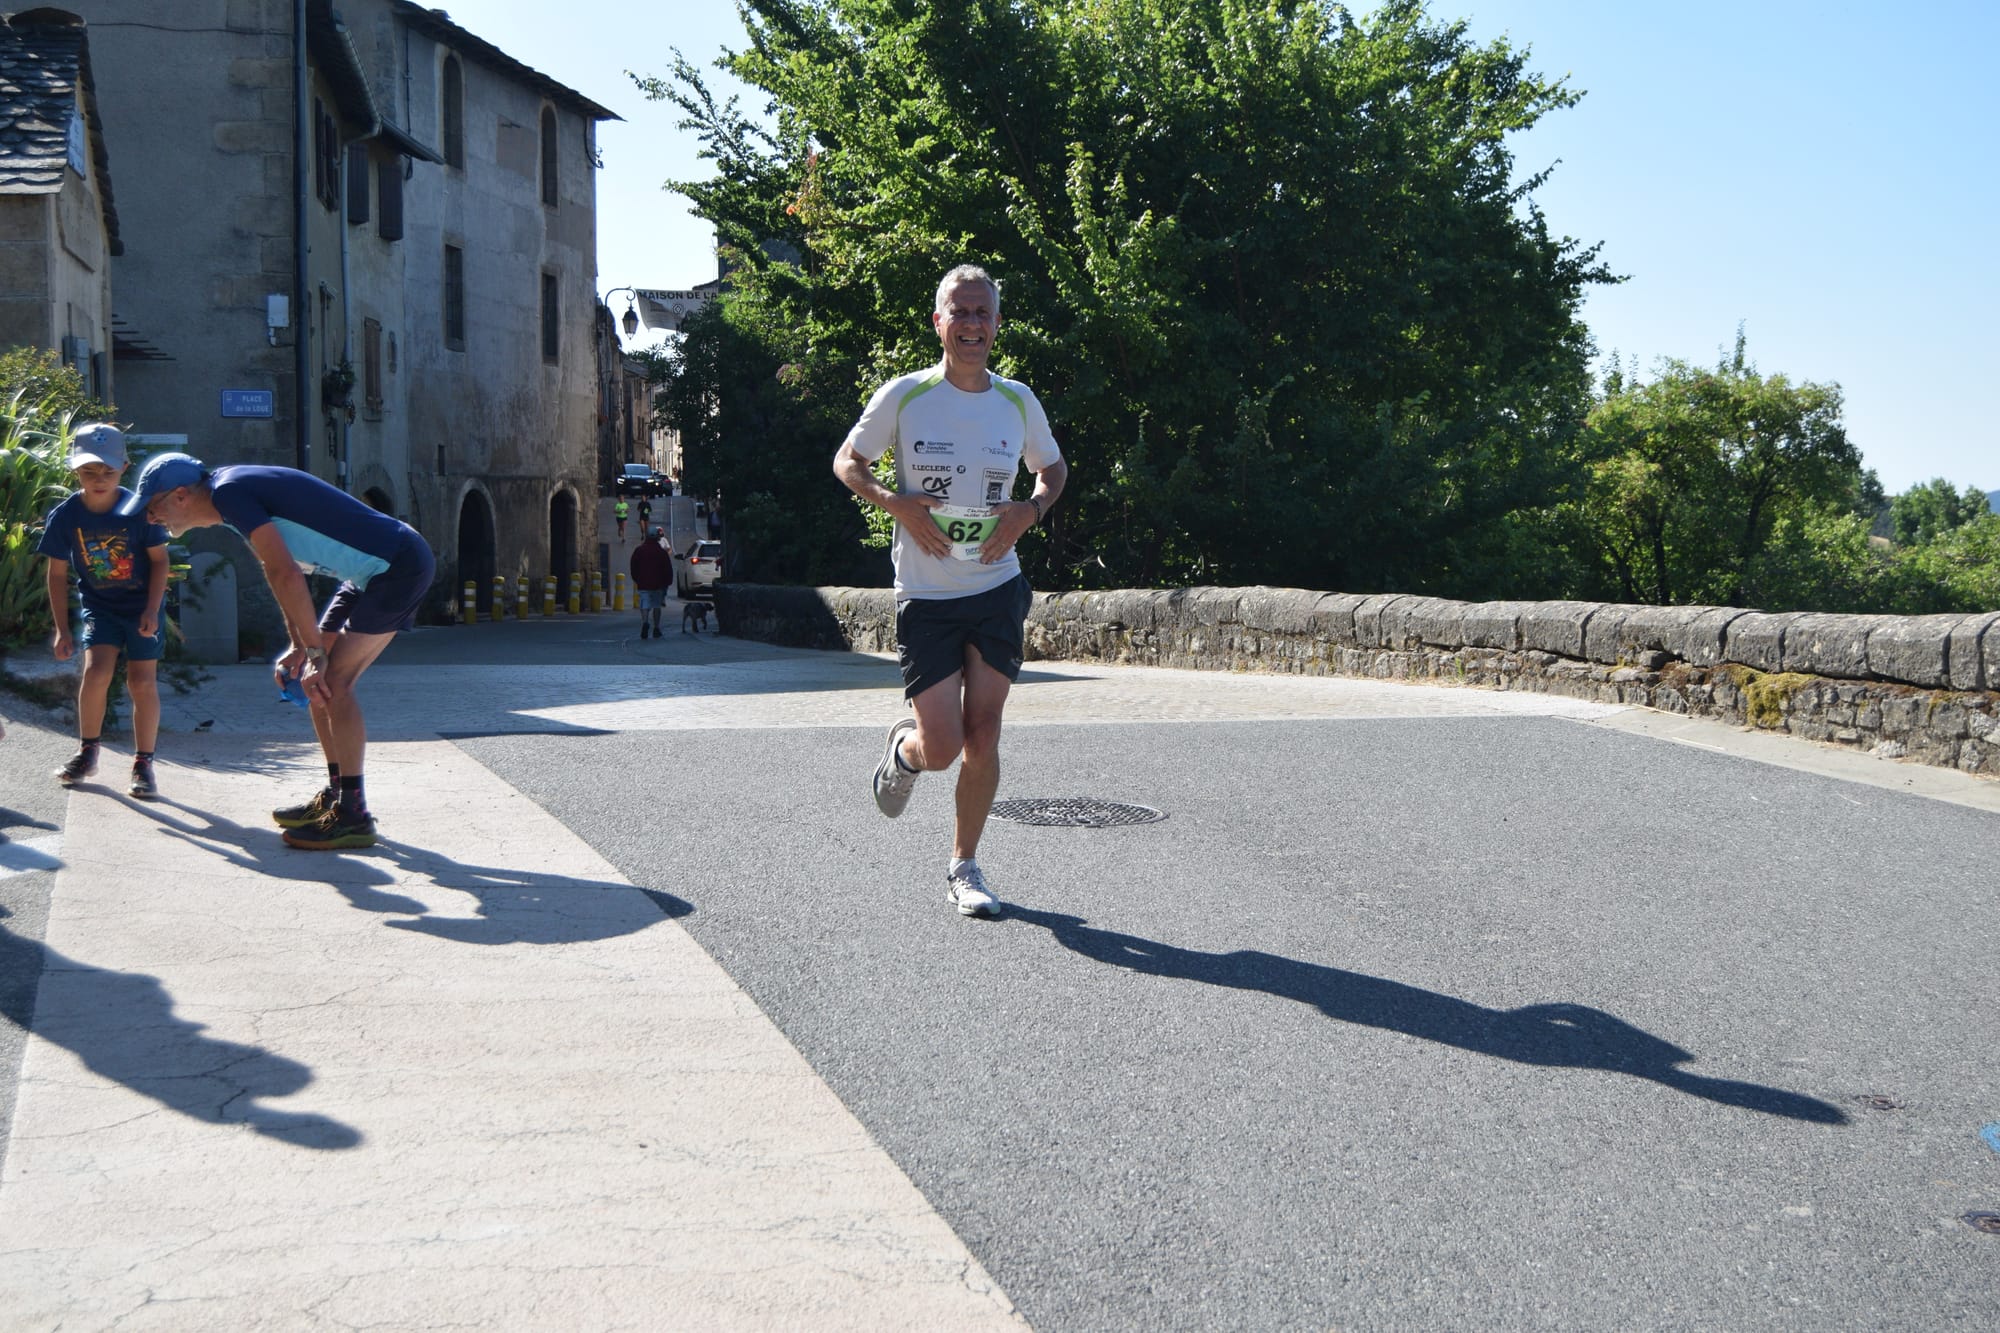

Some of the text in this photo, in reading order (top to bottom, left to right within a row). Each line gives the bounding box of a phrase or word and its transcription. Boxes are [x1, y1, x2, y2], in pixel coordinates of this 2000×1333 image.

[639, 291, 718, 300] MAISON DE L'A
[242, 395, 262, 403] PLACE
[948, 520, 983, 543] 62
